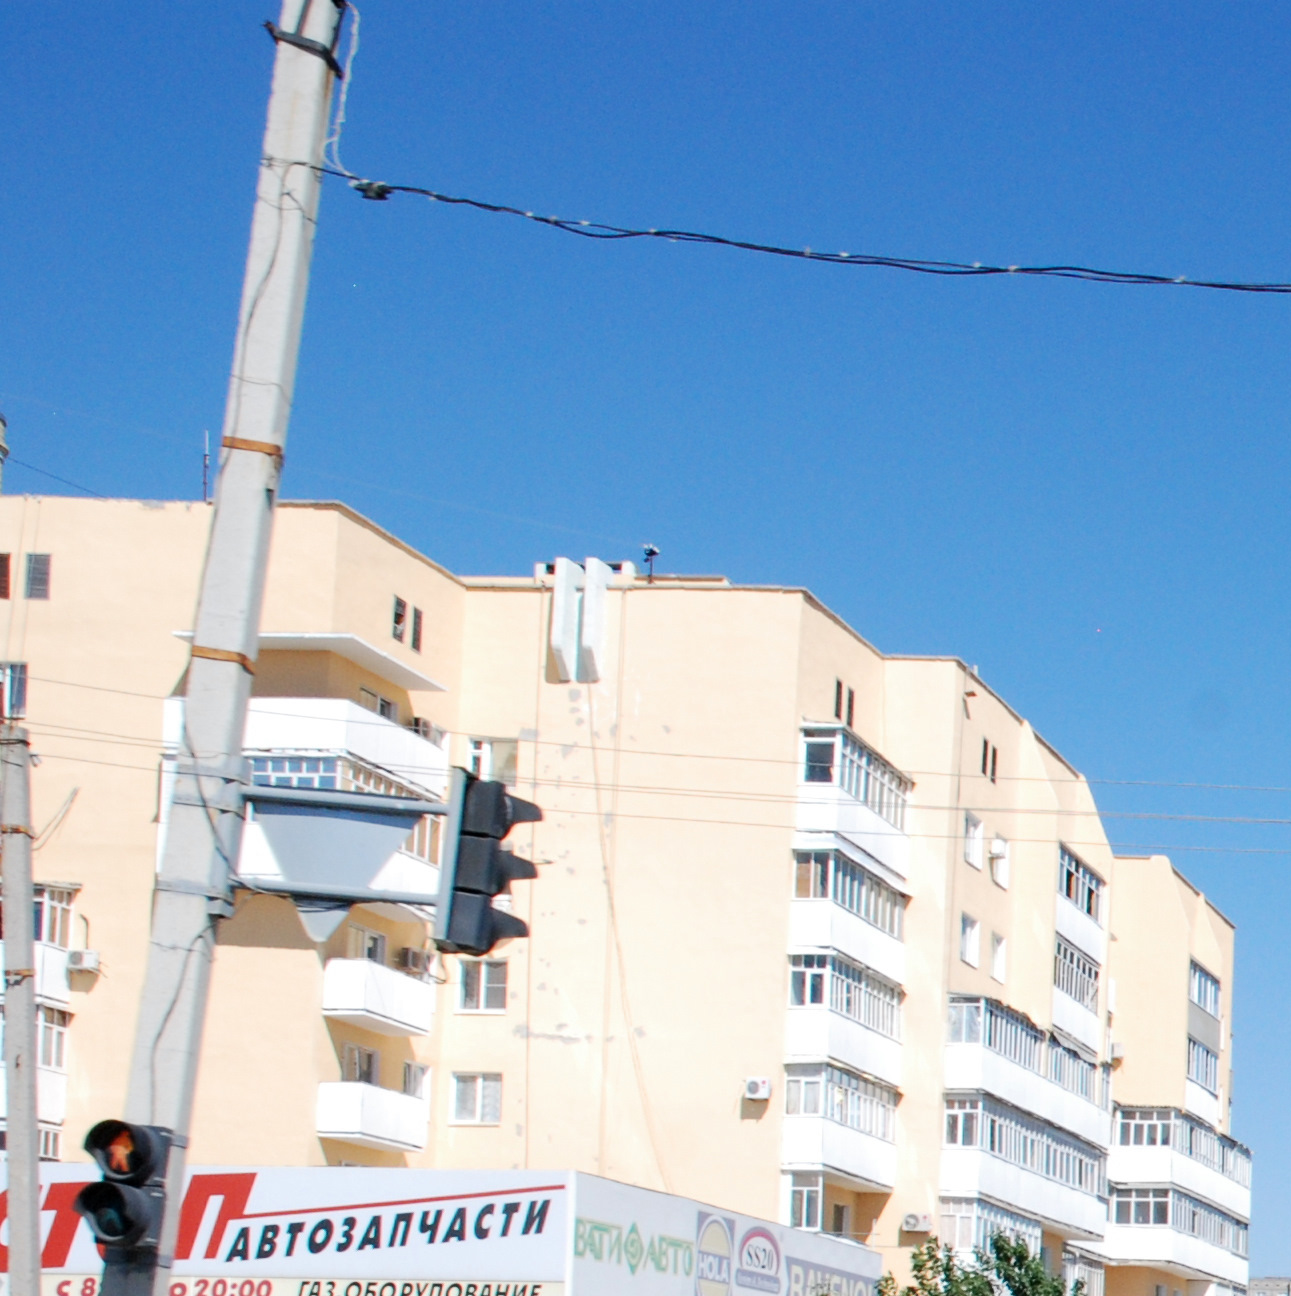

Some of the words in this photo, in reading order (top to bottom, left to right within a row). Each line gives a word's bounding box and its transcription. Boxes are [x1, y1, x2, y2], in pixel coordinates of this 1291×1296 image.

[225, 1199, 552, 1262] АВТОЗАПЧАСТИ
[698, 1252, 730, 1284] HOLA
[745, 1244, 774, 1271] SS20
